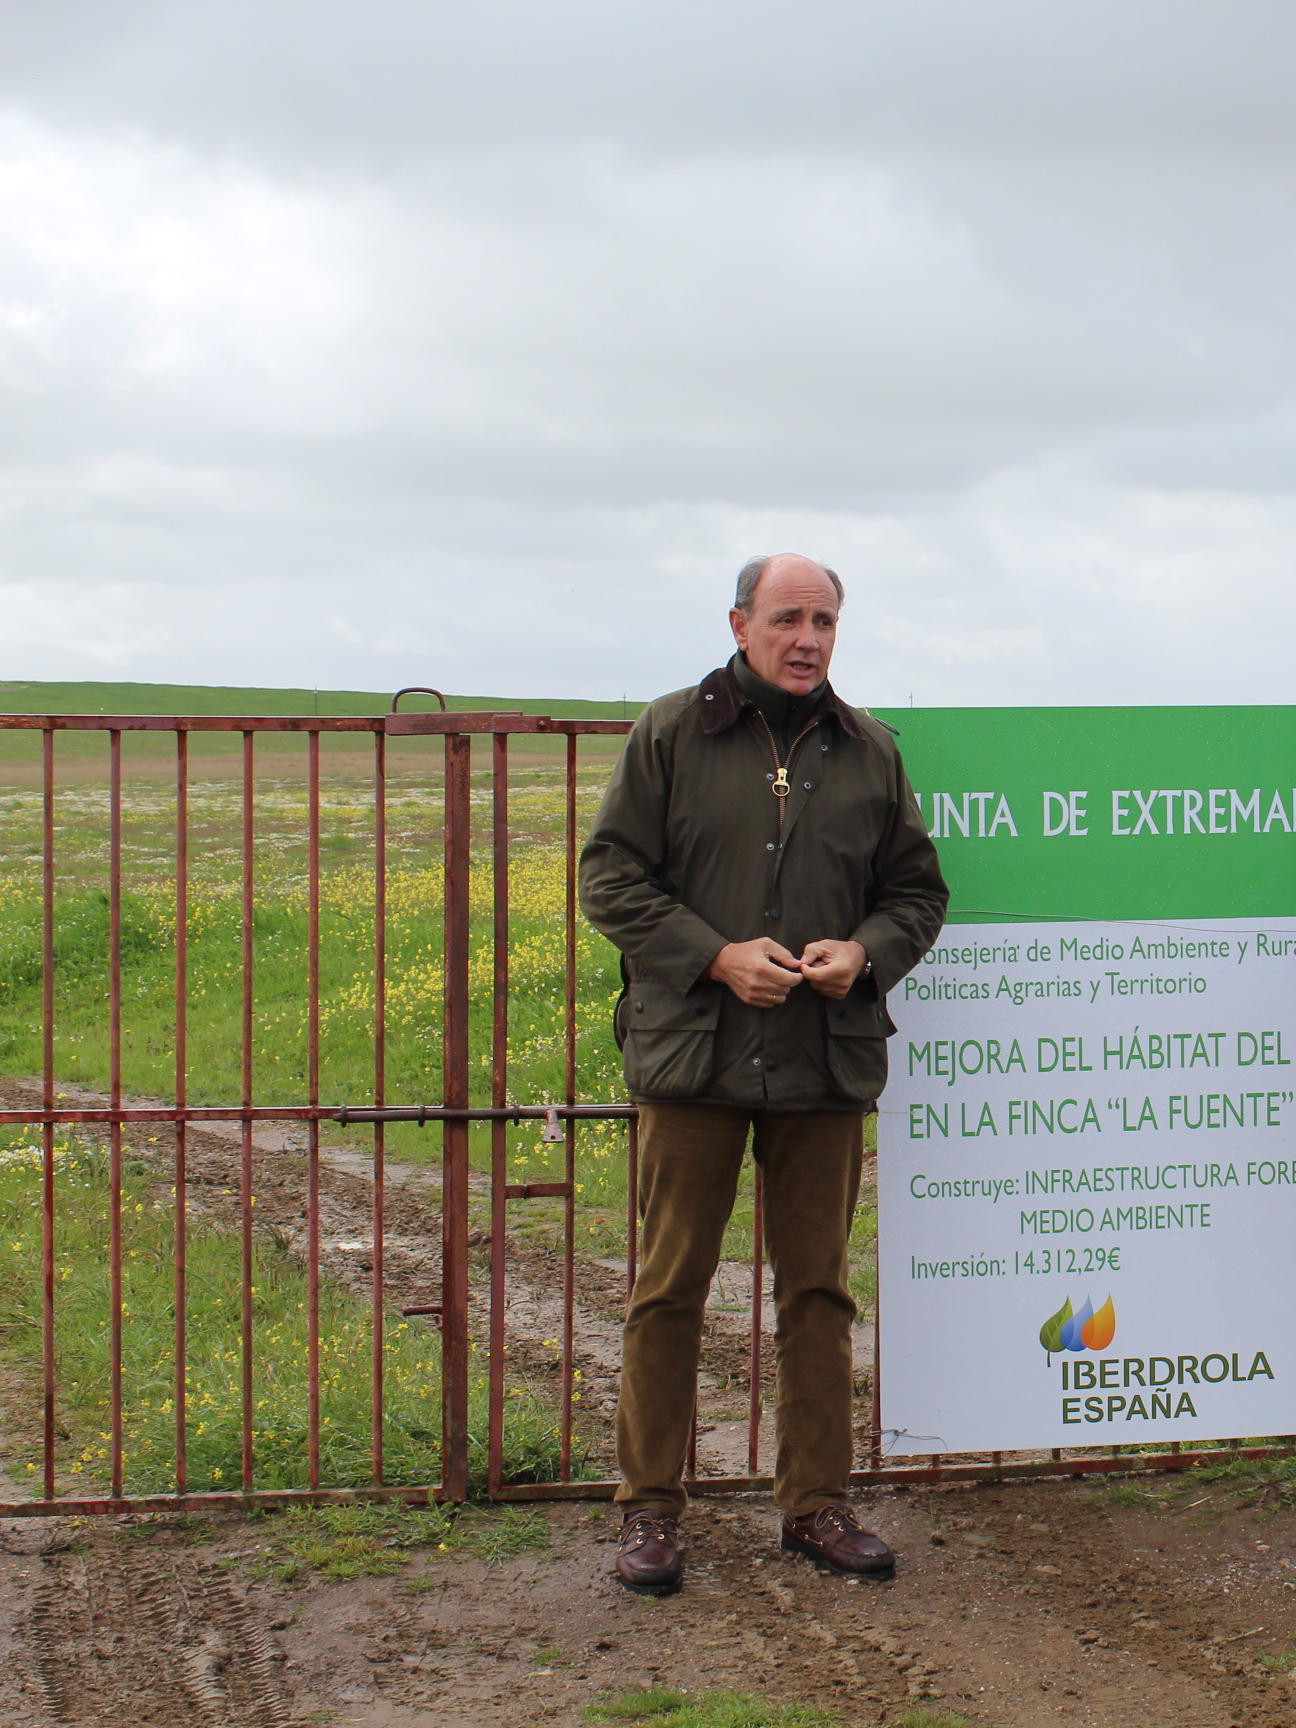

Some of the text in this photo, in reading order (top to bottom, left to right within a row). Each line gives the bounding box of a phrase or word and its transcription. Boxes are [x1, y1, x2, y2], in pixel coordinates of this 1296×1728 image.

[914, 792, 1019, 838] UNTA
[1042, 790, 1089, 837] DE
[919, 939, 1018, 971] onsejería
[1027, 939, 1052, 963] de
[1060, 937, 1124, 961] Medio
[1129, 936, 1230, 959] Ambiente
[1236, 941, 1249, 964] y
[905, 972, 1207, 1006] Políticas Agrarias y Territorio
[908, 1038, 1027, 1086] MEJORA
[1037, 1036, 1093, 1073] DEL
[1103, 1025, 1227, 1070] HÁBITAT
[1237, 1030, 1291, 1067] DEL
[909, 1090, 1294, 1139] EN LA FINCA “LA FUENTE”
[909, 1173, 1020, 1203] Construye:
[1025, 1162, 1240, 1194] INFRAESTRUCTURA
[1020, 1203, 1211, 1234] MEDIO AMBIENTE
[910, 1246, 1121, 1279] Inversión: 14.312,29€
[1061, 1351, 1275, 1391] IBERDROLA
[1061, 1387, 1198, 1424] ESPAÑA
